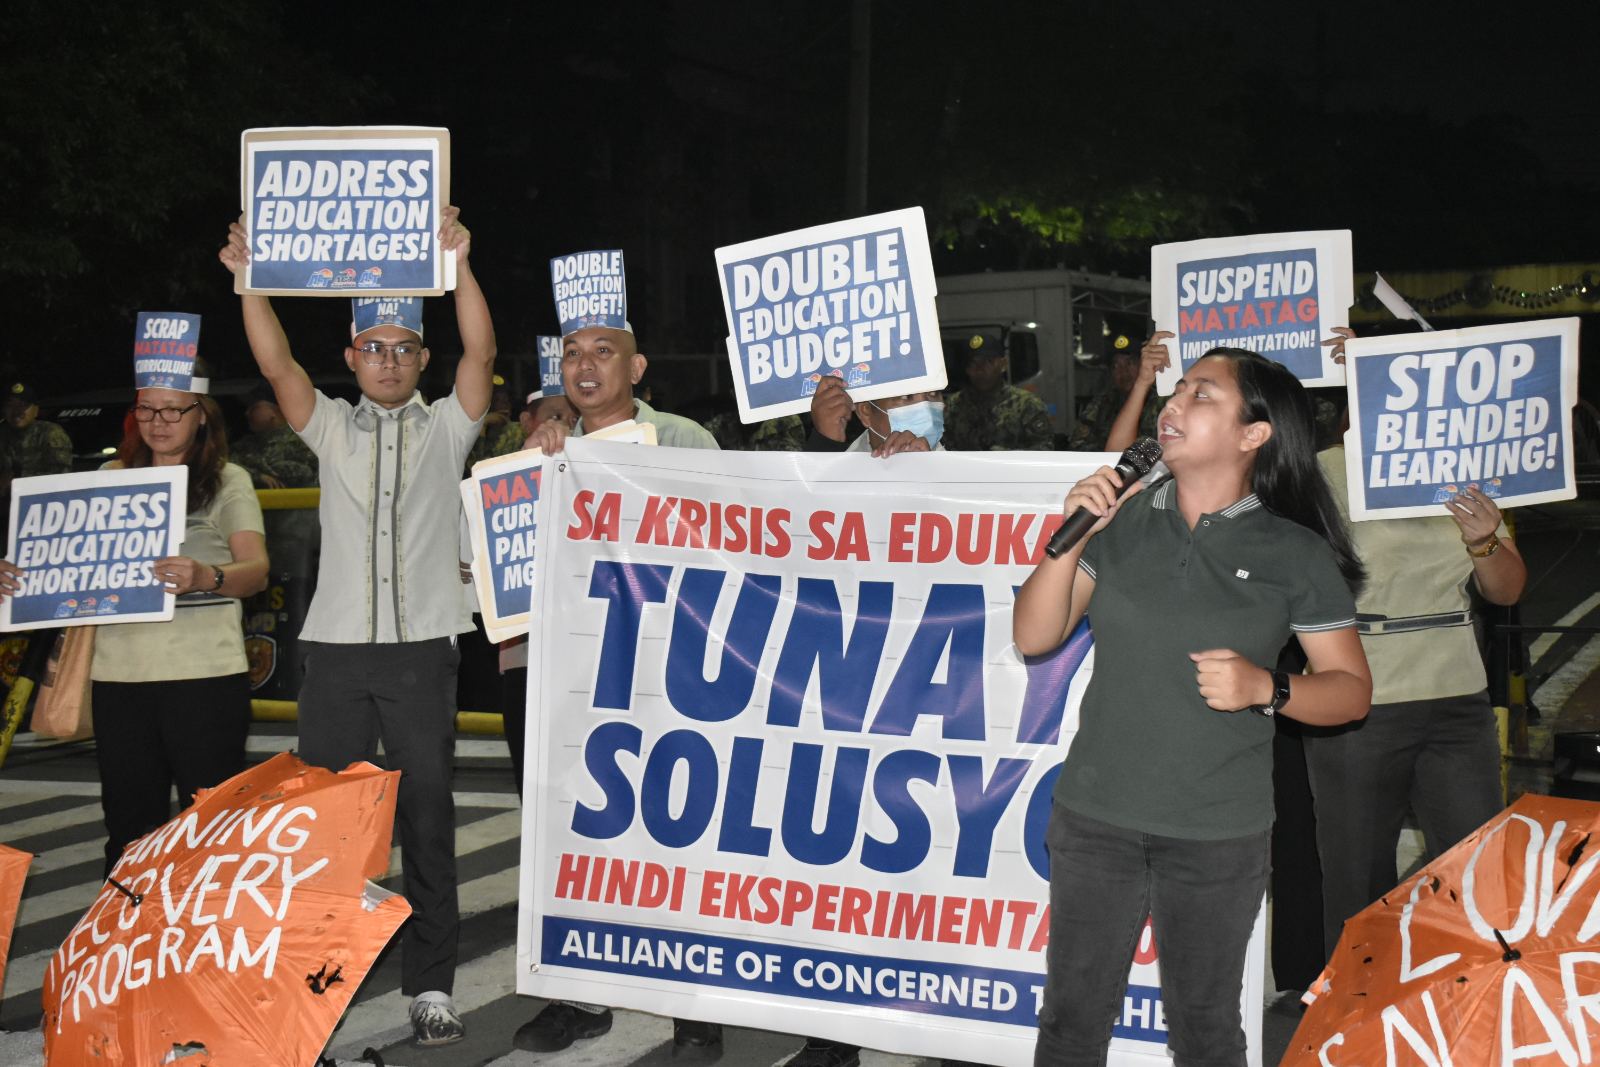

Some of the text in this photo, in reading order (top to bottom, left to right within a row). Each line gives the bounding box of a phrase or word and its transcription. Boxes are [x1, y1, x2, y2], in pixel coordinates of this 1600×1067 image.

[256, 160, 430, 197] ADDRESS
[256, 200, 430, 230] EDUCATION
[254, 232, 431, 262] SHORTAGES!
[553, 252, 620, 283] DOUBLE
[734, 232, 899, 310] DOUBLE
[1179, 260, 1314, 307] SUSPEND
[555, 275, 623, 302] EDUCATION
[559, 293, 623, 323] BUDGET!
[143, 318, 189, 339] SCRAP
[377, 303, 399, 315] NA!
[739, 280, 907, 344] EDUCATION
[1179, 296, 1318, 334] MATATAG
[135, 340, 197, 358] MATATAG
[136, 359, 193, 376] CURRICULUM!
[747, 312, 911, 385] BUDGET!
[1385, 343, 1535, 411] STOP
[58, 408, 102, 417] MEDIA
[1376, 396, 1549, 452] BLENDED
[1369, 432, 1558, 488] LEARNING!
[18, 492, 169, 538] ADDRESS
[566, 489, 622, 542] SA
[635, 495, 791, 559] KRISIS
[807, 510, 871, 562] SA
[17, 529, 167, 568] EDUCATION
[13, 560, 160, 598] SHORTAGES
[588, 559, 1095, 746] TUNAY
[554, 853, 687, 912] HINDI
[56, 924, 281, 1035] PROGRAM
[561, 929, 724, 976] ALLIANCE
[735, 950, 782, 982] OF
[793, 958, 1018, 1012] CONCERNED
